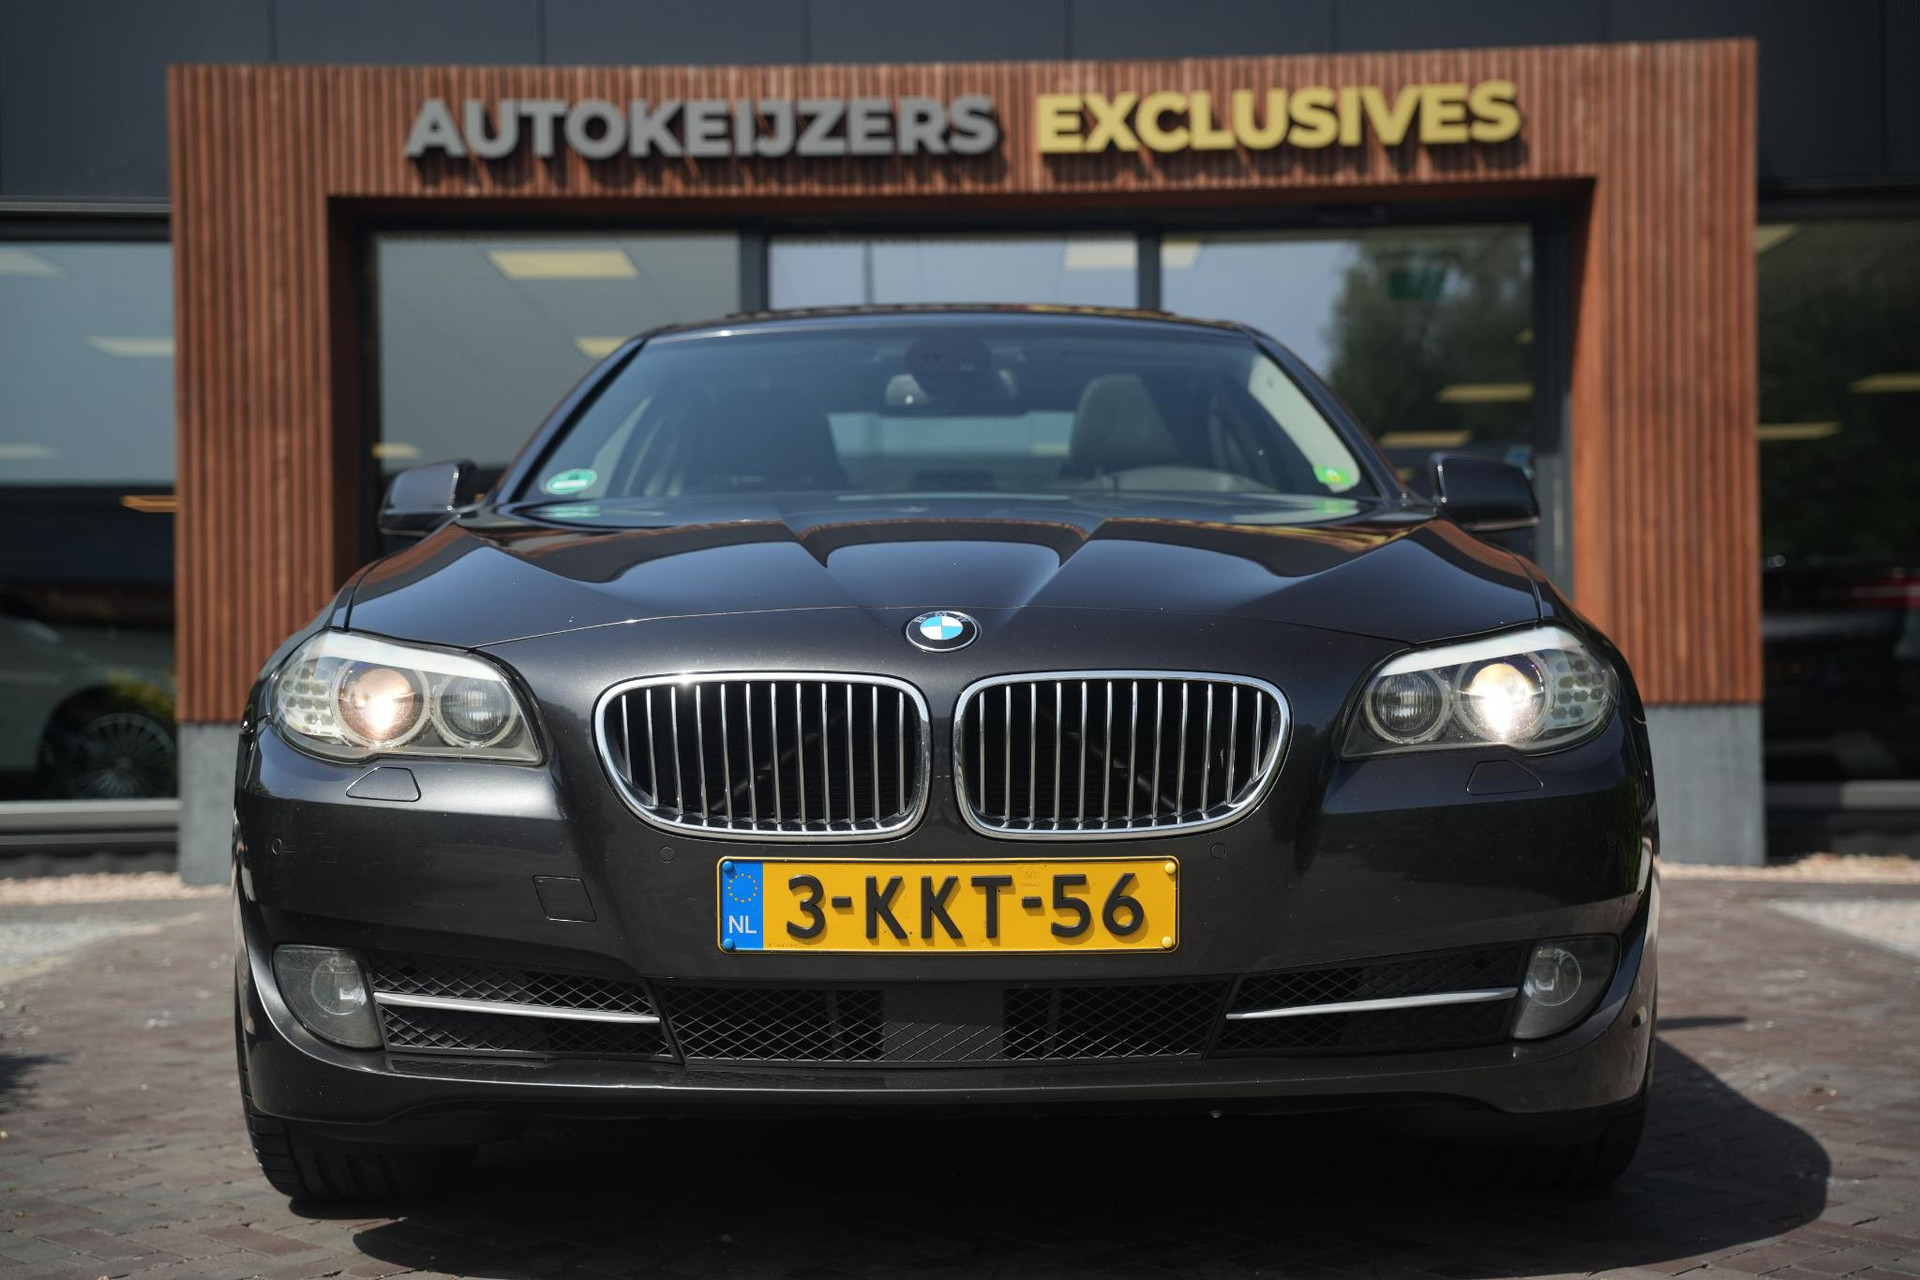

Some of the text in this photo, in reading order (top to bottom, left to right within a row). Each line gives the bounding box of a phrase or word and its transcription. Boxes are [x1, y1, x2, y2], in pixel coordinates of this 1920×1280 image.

[404, 80, 1522, 158] AUTOKEIJZERS EXCLUSIVES
[728, 915, 757, 934] NL
[786, 872, 1145, 939] 3-KKT-56
